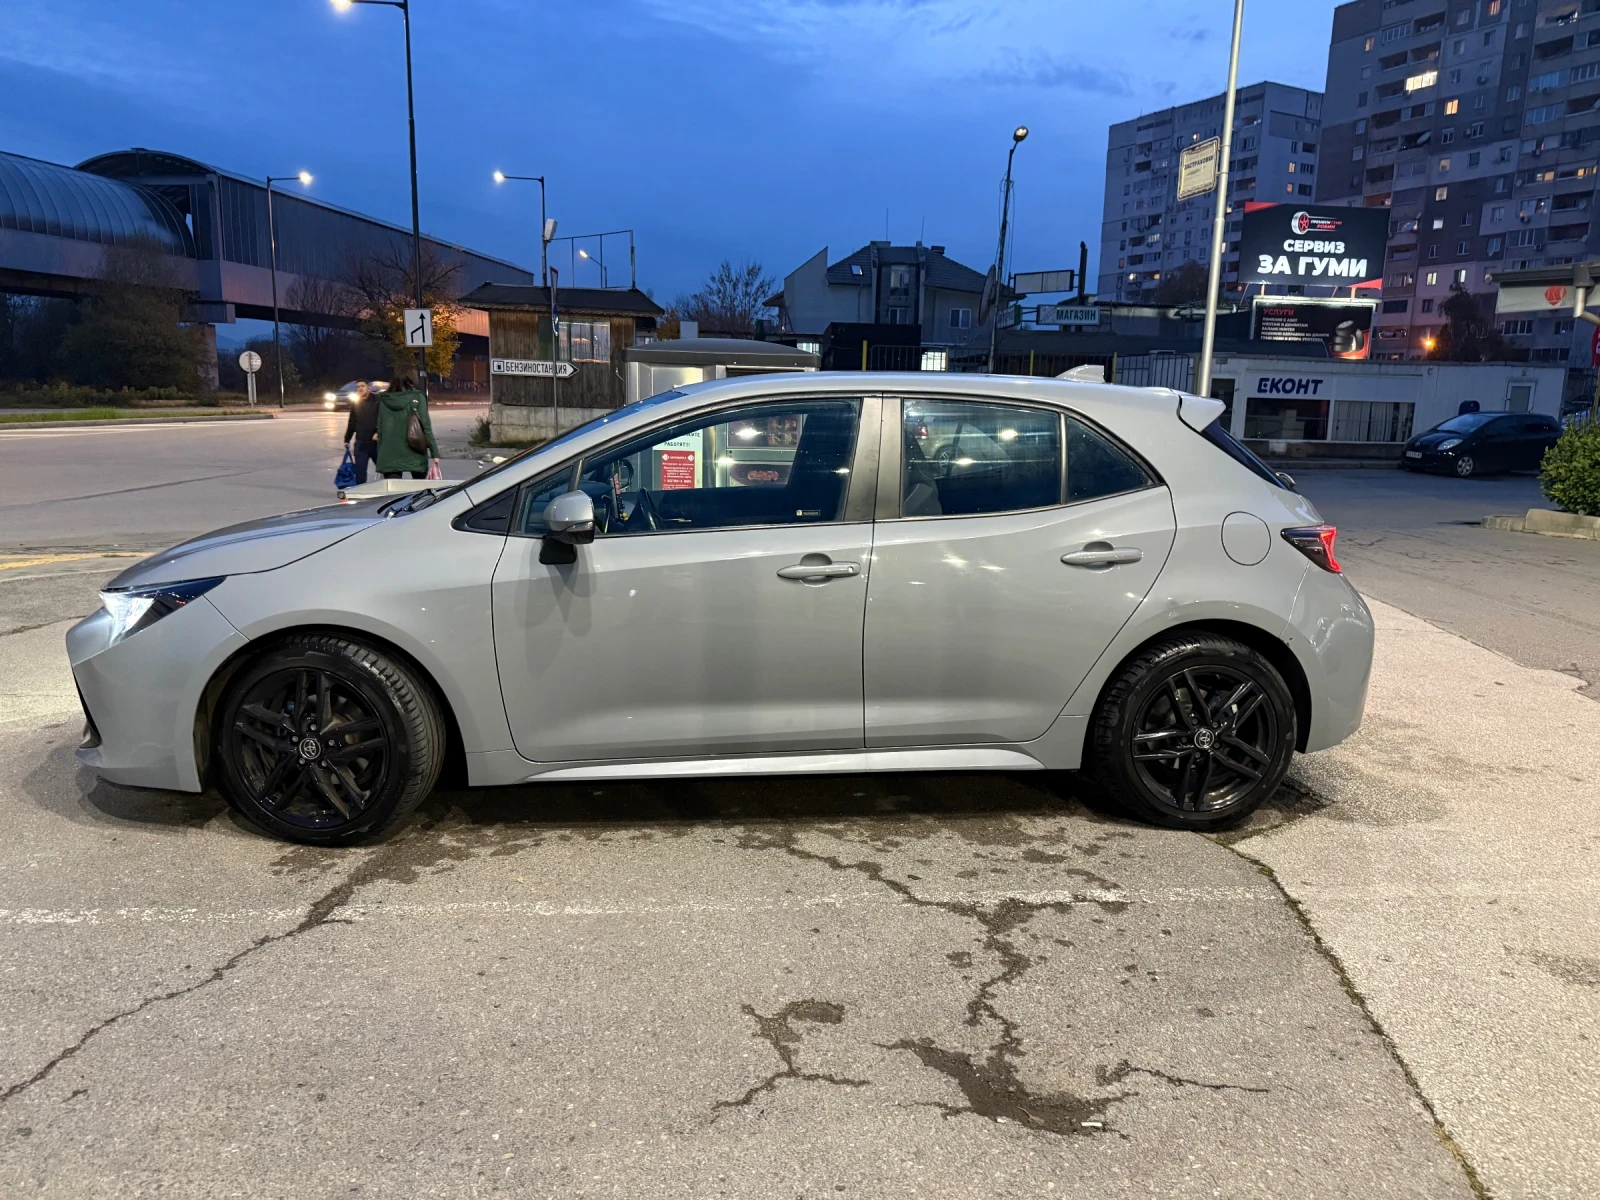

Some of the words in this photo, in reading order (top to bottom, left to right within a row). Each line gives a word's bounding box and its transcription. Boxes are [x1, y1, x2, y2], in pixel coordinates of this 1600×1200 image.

[1283, 239, 1346, 254] СЕРВИЗ
[1257, 254, 1292, 275] ЗА
[1298, 256, 1368, 278] ГУМИ
[1056, 309, 1096, 321] МАГАЗИН
[1263, 308, 1295, 316] УСЛУГИ
[1257, 377, 1324, 395] ЕКОНТ
